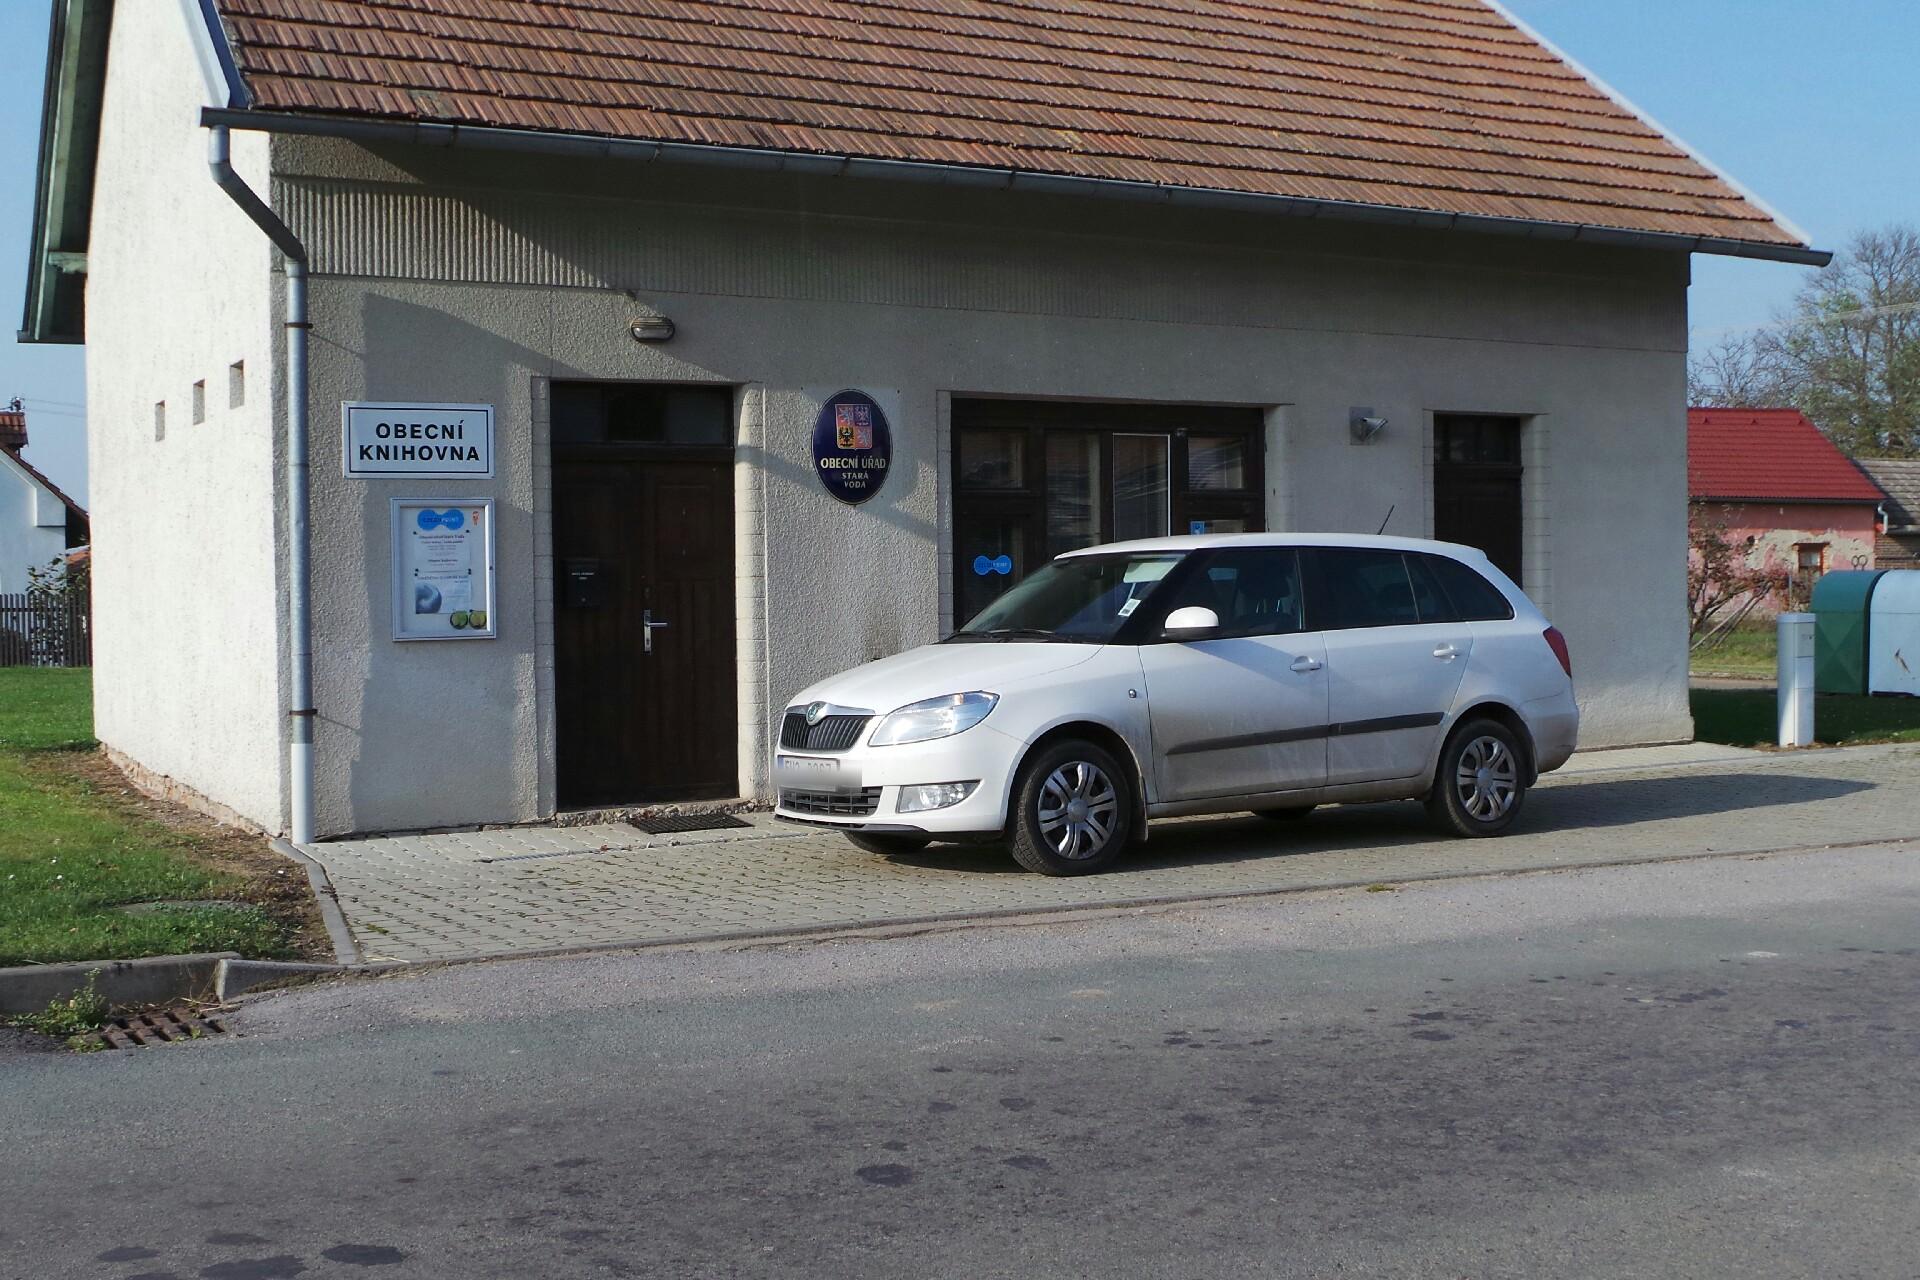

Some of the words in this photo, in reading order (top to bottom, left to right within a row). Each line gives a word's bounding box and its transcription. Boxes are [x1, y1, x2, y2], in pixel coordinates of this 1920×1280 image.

[375, 420, 464, 440] OBECNÍ
[359, 444, 480, 461] KNIHOVNA
[820, 455, 858, 469] OBECNÍ
[861, 455, 886, 469] ÚŘAD
[841, 471, 869, 480] STARÁ
